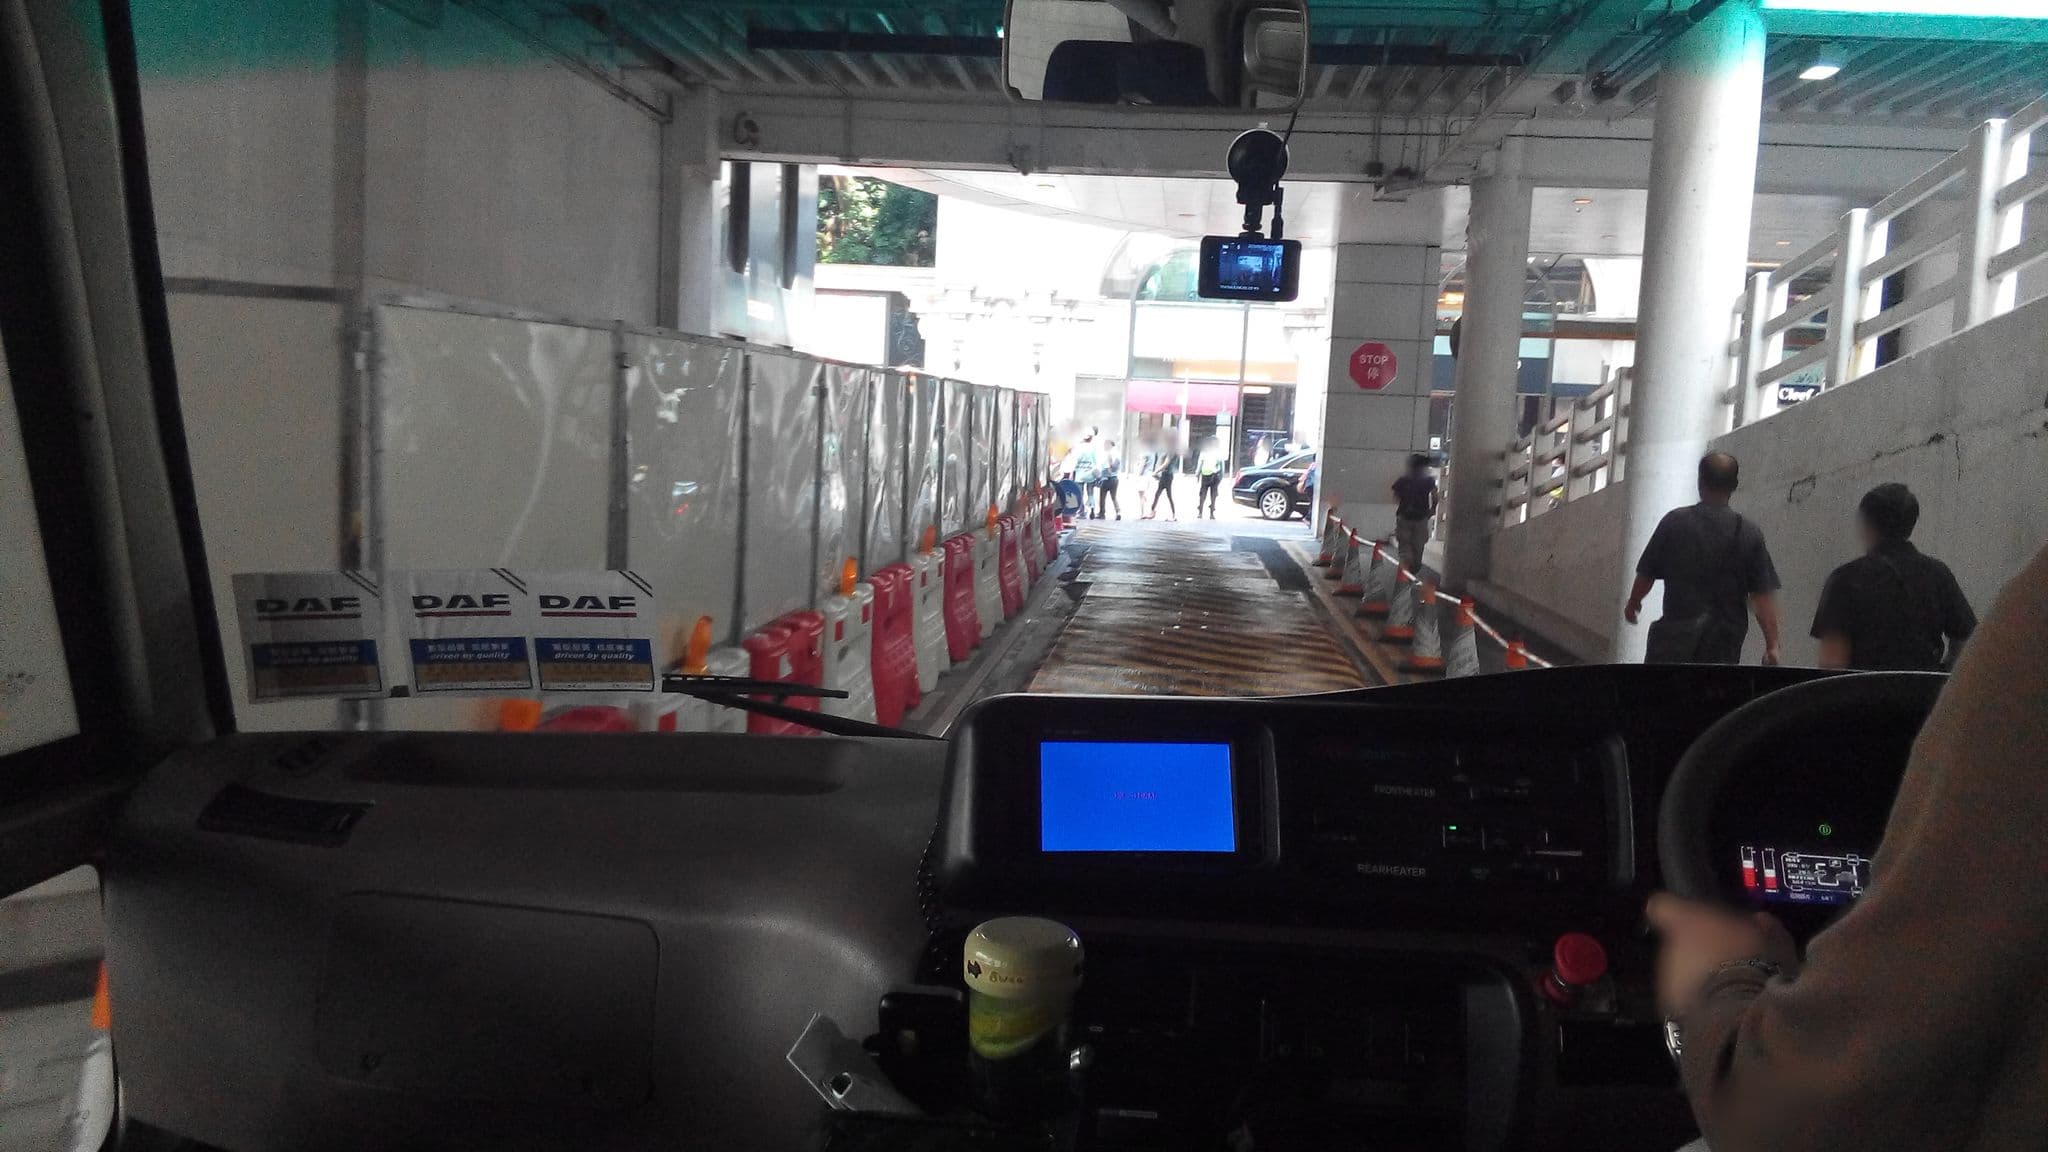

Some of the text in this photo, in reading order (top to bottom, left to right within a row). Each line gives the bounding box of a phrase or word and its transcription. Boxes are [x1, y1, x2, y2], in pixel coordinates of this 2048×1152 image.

[1359, 354, 1389, 365] STOP
[256, 597, 361, 613] DAF
[411, 594, 510, 609] DAF
[538, 595, 636, 610] DAF
[476, 651, 511, 660] quality
[554, 652, 635, 661] driven by quality
[1358, 863, 1426, 877] REARHEATER
